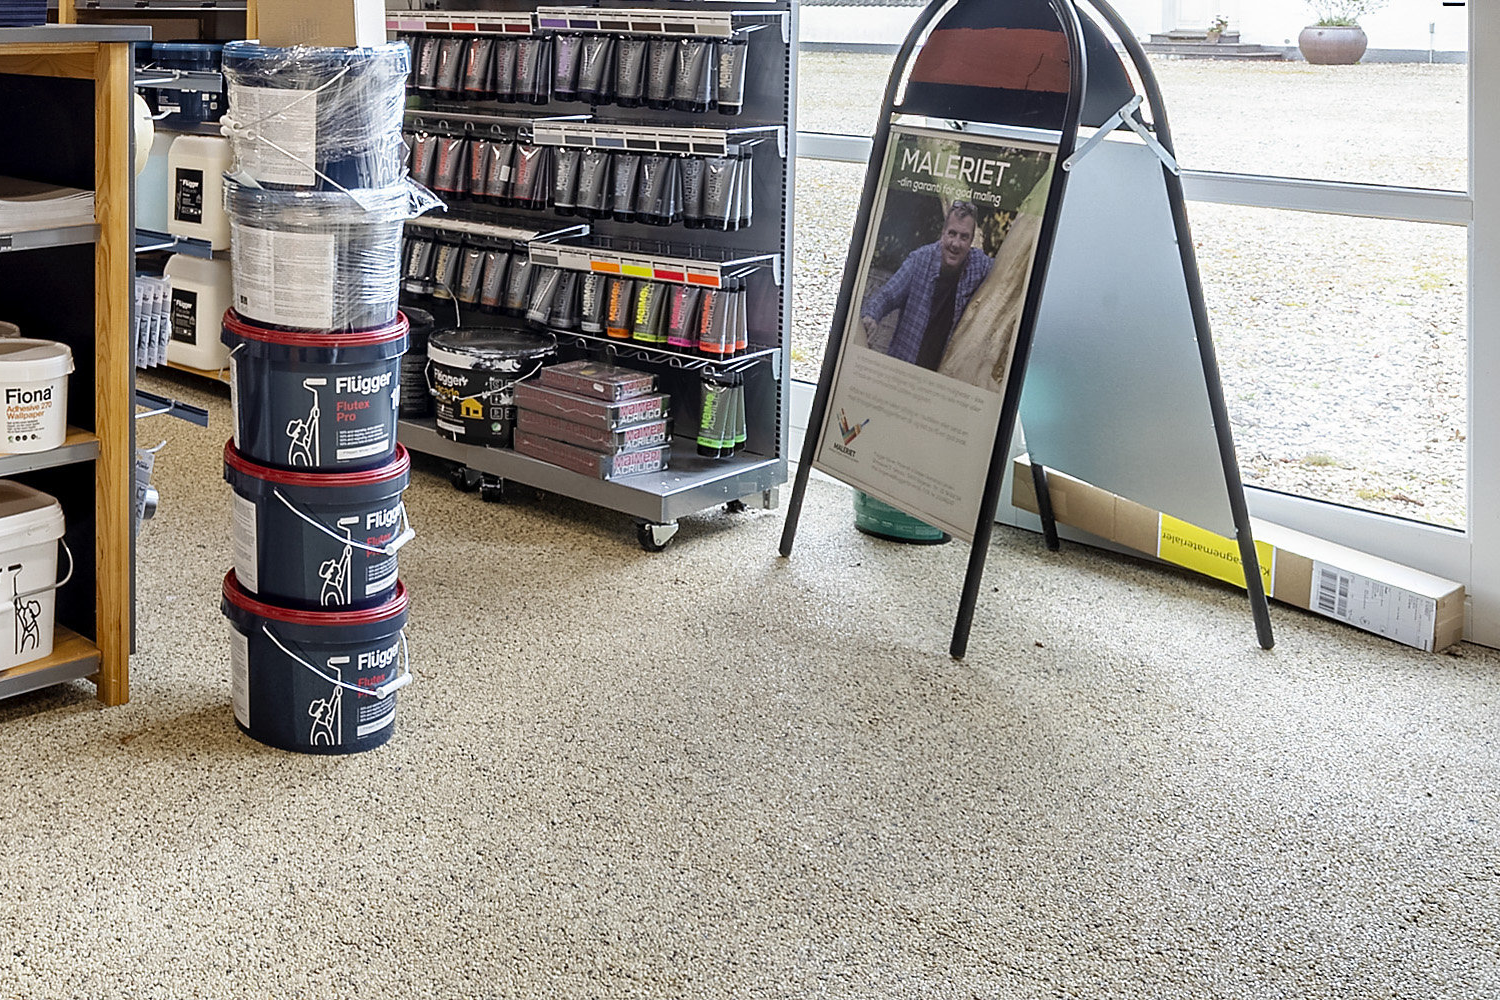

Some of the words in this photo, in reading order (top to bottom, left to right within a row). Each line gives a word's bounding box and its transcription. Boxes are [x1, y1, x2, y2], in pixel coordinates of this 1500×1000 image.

[900, 147, 1011, 187] MALERIET
[913, 180, 942, 192] garanti
[942, 183, 955, 195] for
[955, 188, 973, 200] god
[973, 191, 1002, 207] maling
[336, 372, 392, 395] Flügger
[6, 410, 45, 420] Wallpaper
[337, 400, 370, 411] Flutex
[337, 412, 357, 422] Pro
[1161, 532, 1270, 577] Kagnematerialer
